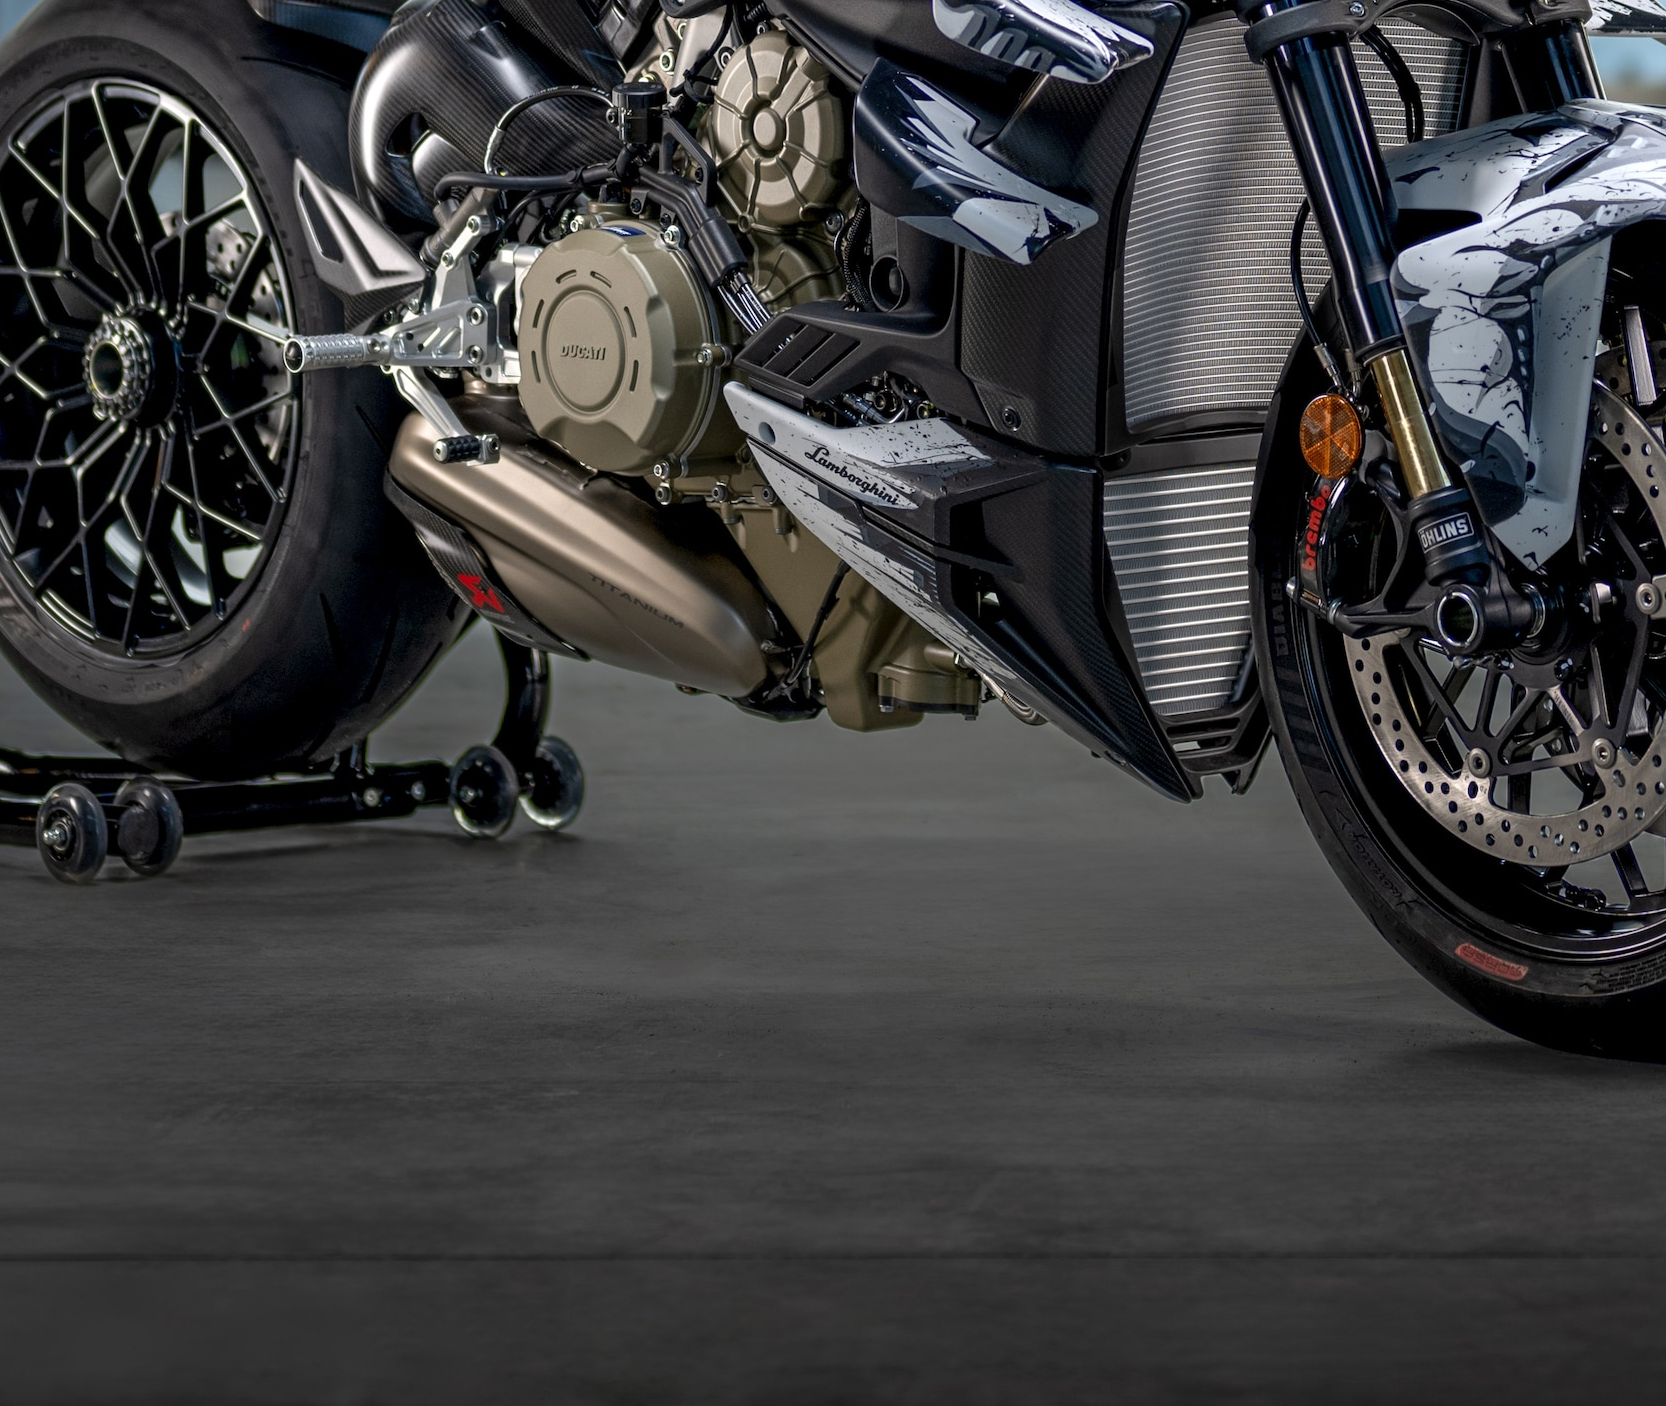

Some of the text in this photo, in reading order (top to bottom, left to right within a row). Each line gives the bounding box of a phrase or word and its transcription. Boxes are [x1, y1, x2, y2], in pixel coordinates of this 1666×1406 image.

[559, 344, 606, 361] DUCATI
[804, 446, 900, 505] Lamborghini
[1302, 484, 1332, 571] brembo
[1420, 518, 1469, 549] ÖHLINS
[587, 571, 684, 629] TITANIUM
[1270, 539, 1290, 656] DIABL
